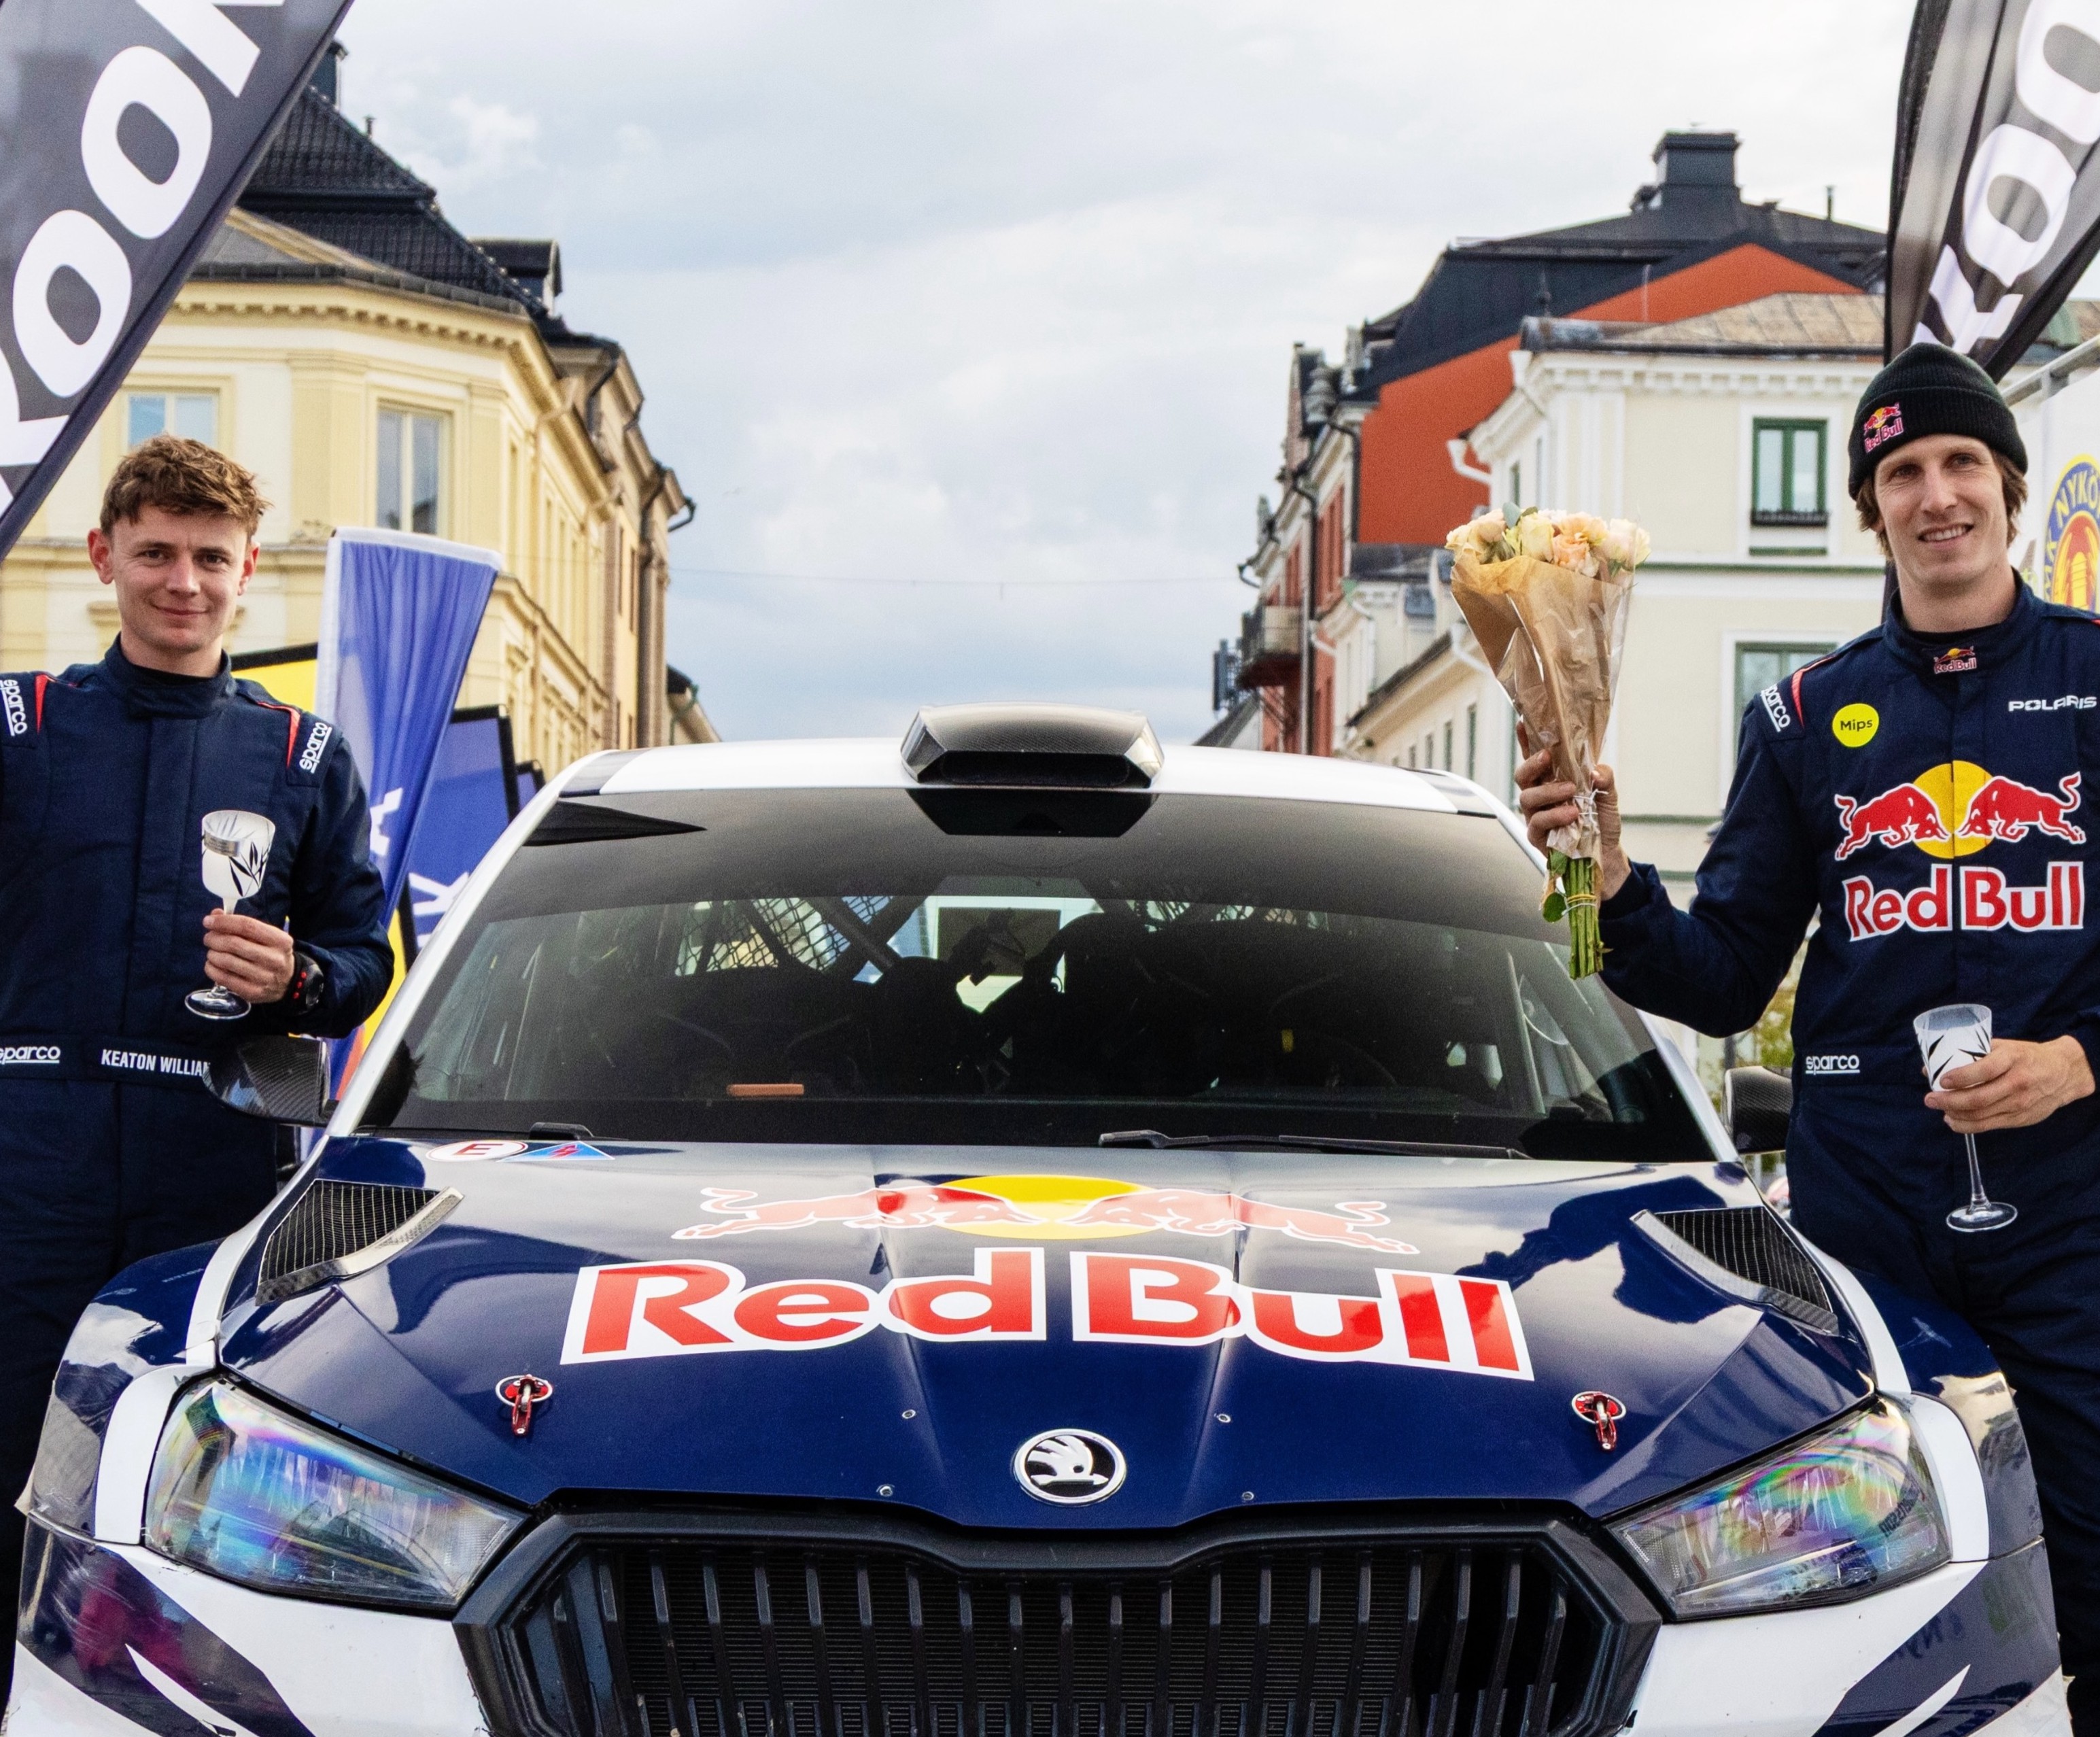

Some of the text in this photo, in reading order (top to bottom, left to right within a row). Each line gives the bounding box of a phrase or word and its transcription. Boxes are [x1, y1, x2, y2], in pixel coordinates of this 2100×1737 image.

[1864, 417, 1904, 453] Red Bull
[2056, 469, 2100, 530] NYKÖ
[1934, 657, 1976, 674] Red Bull
[0, 678, 28, 736] sparco
[1760, 683, 1791, 732] parco
[2008, 695, 2097, 712] POLARIS
[1840, 719, 1873, 732] Mips
[299, 722, 332, 774] sparco
[1842, 861, 2085, 942] Red Bull
[101, 1049, 156, 1071] KEATON
[1806, 1054, 1860, 1075] sparco
[452, 1143, 504, 1156] E
[560, 1248, 1534, 1381] Red Bull
